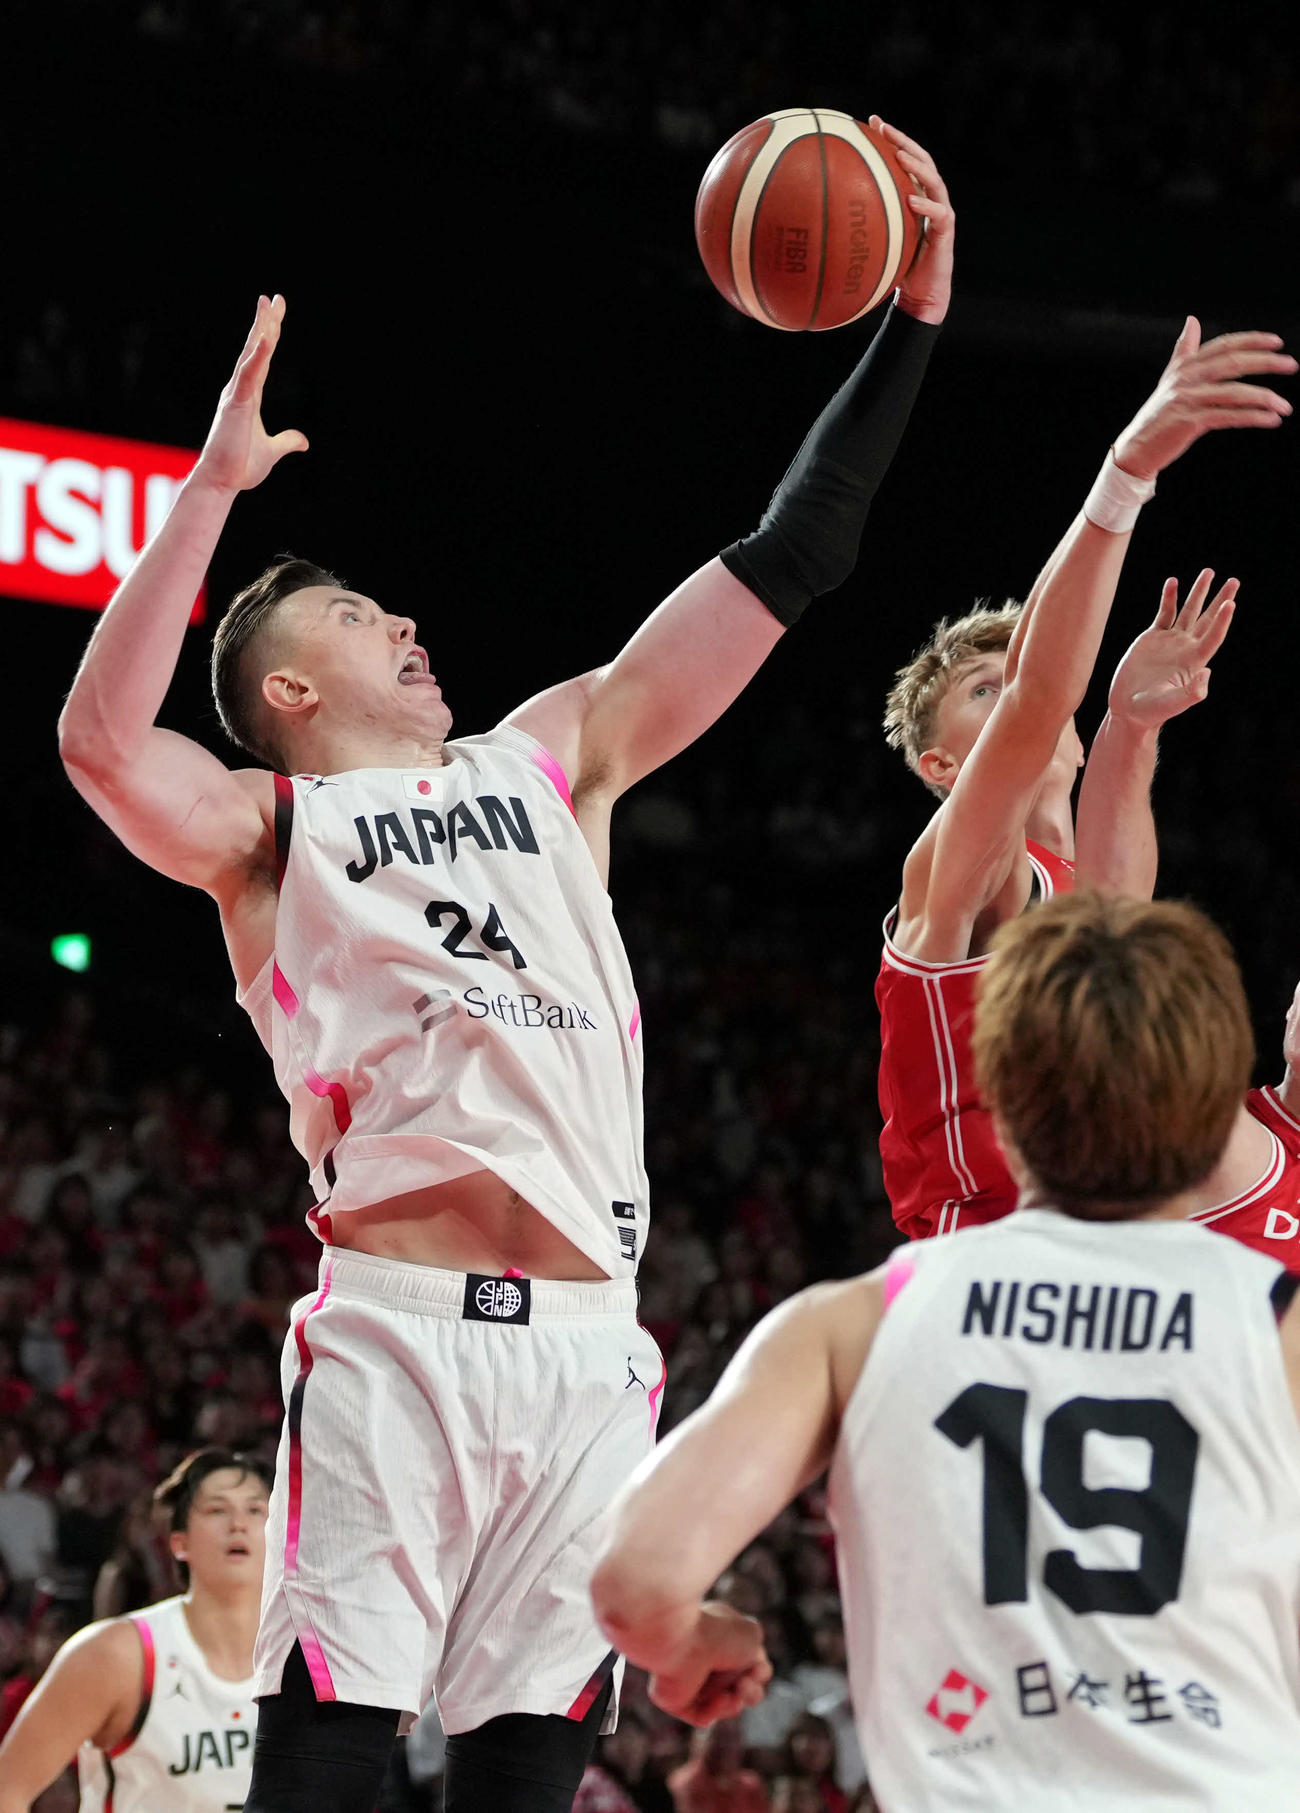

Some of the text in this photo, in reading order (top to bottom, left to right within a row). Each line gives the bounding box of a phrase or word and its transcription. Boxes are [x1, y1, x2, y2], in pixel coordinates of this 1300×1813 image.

[786, 227, 808, 273] FIBA
[843, 201, 870, 295] molten
[0, 447, 186, 580] TSU
[345, 795, 540, 883] JAPAN
[424, 901, 527, 969] 24
[962, 1281, 1193, 1352] NISHIDA
[933, 1382, 1199, 1617] 19
